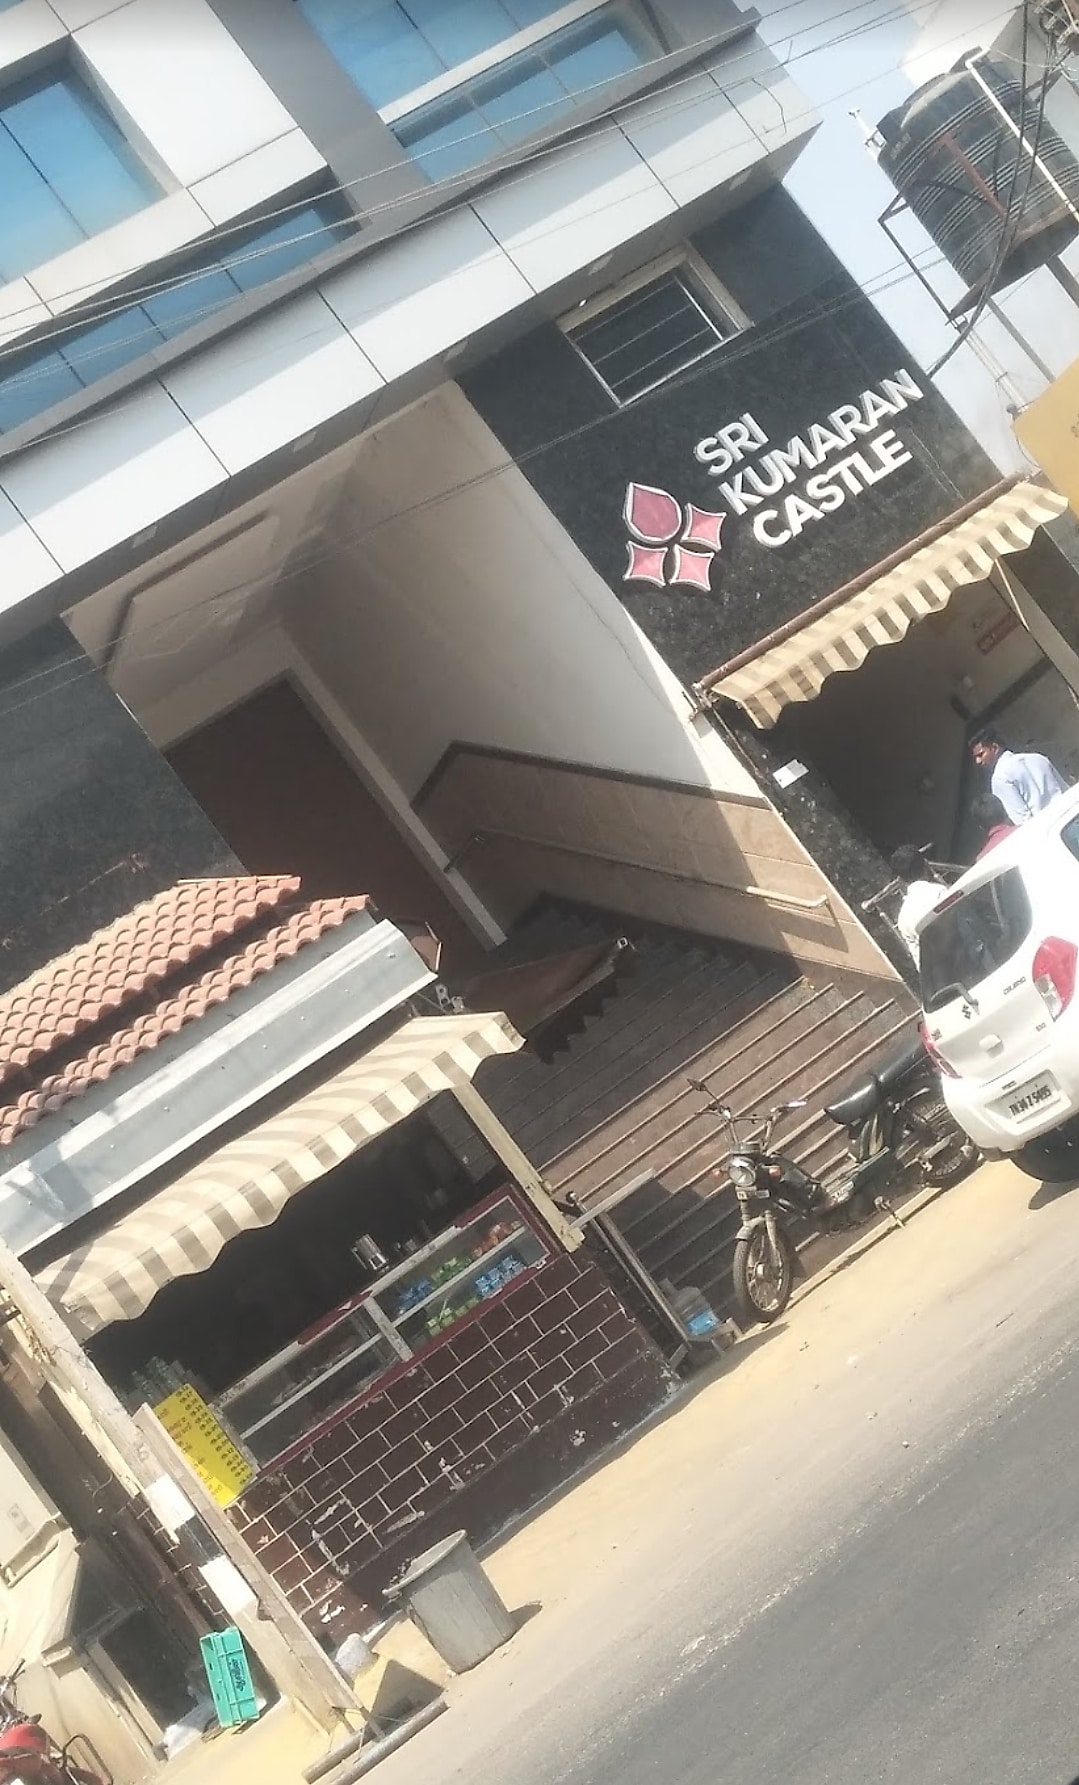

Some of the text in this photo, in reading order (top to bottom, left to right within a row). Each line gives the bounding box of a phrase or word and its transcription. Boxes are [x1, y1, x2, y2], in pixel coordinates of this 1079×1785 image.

[694, 412, 769, 475] SRI
[718, 368, 924, 516] KUMARAN
[752, 429, 913, 548] CASTLE
